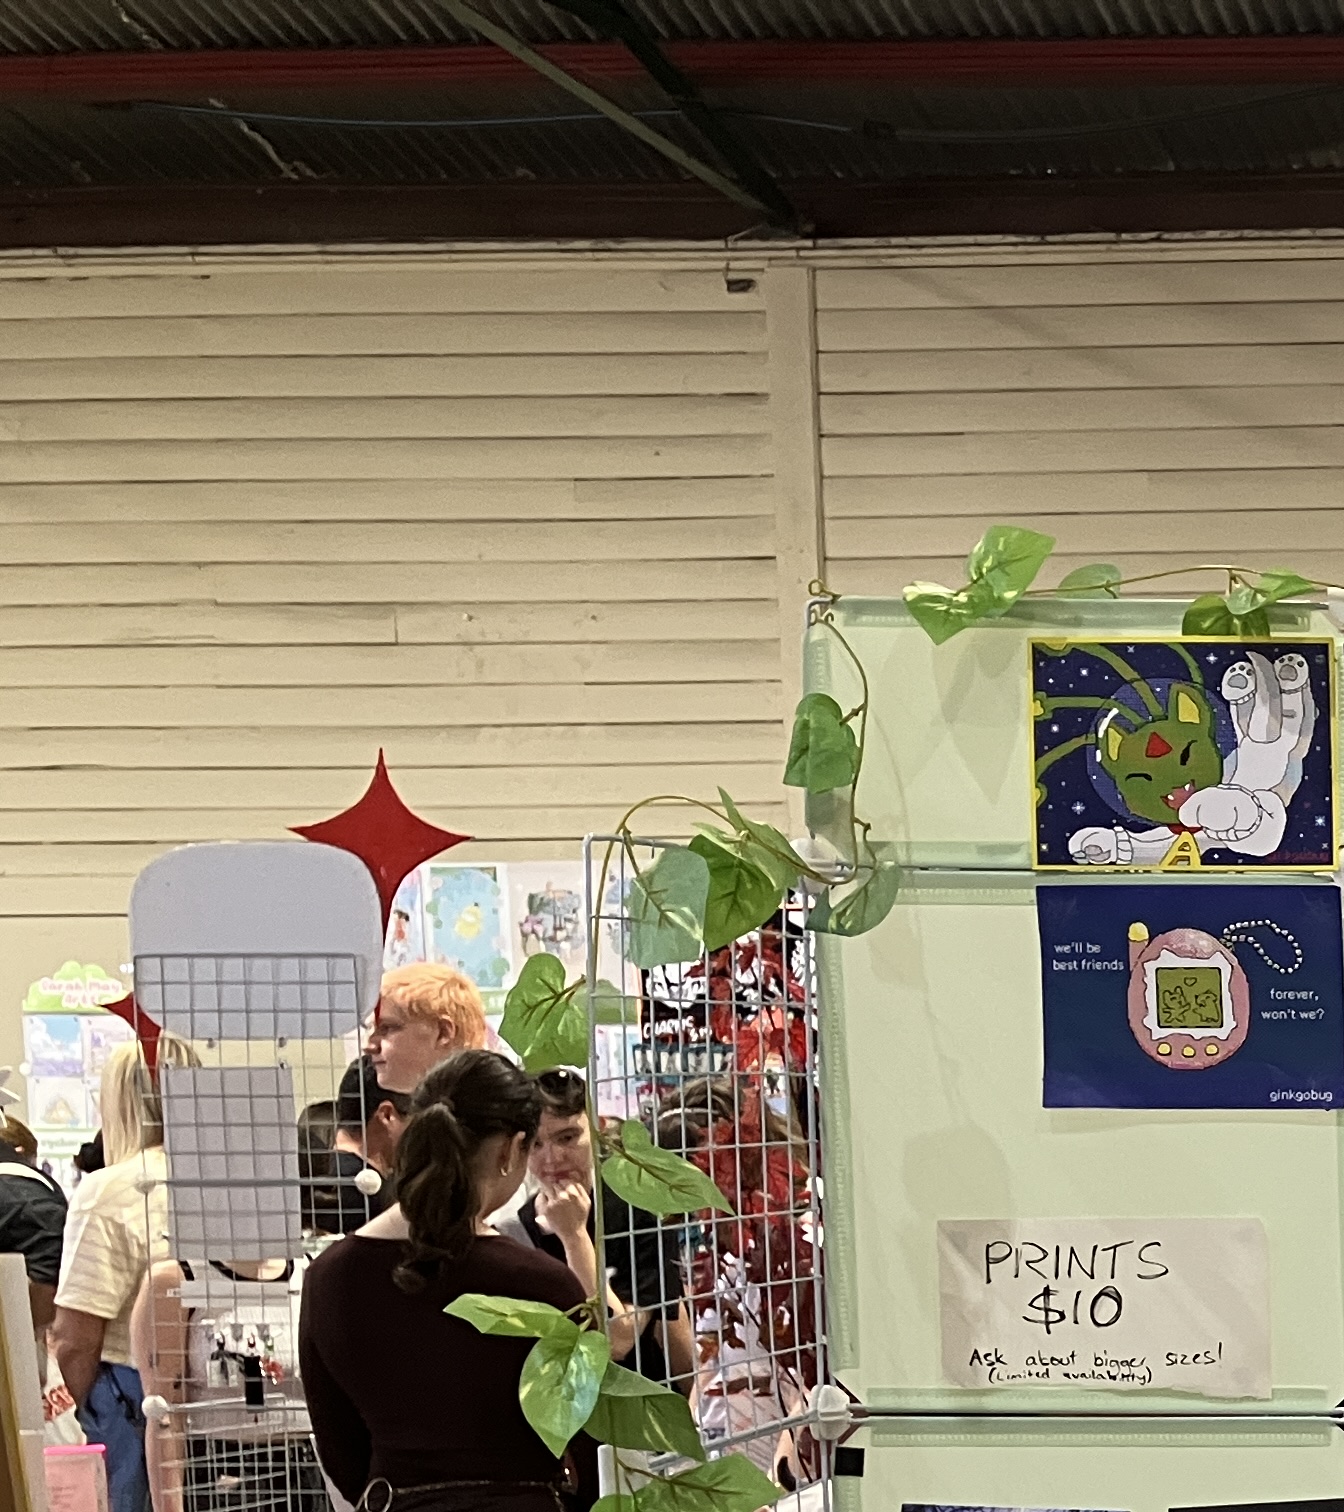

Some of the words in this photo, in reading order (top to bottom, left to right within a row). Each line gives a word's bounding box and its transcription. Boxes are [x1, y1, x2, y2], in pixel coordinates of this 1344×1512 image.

[1054, 942, 1083, 953] we'll
[1087, 942, 1101, 953] be
[1053, 959, 1078, 971] best
[1081, 958, 1124, 971] friends
[1270, 988, 1319, 1001] forever,
[1261, 1009, 1296, 1020] won't
[1300, 1009, 1325, 1020] we?
[1269, 1089, 1333, 1102] ginkgobug
[985, 1240, 1170, 1284] PRINTS
[1022, 1284, 1123, 1335] $10
[969, 1348, 1007, 1367] Ask
[1025, 1350, 1077, 1367] about
[1165, 1342, 1223, 1368] sizes!
